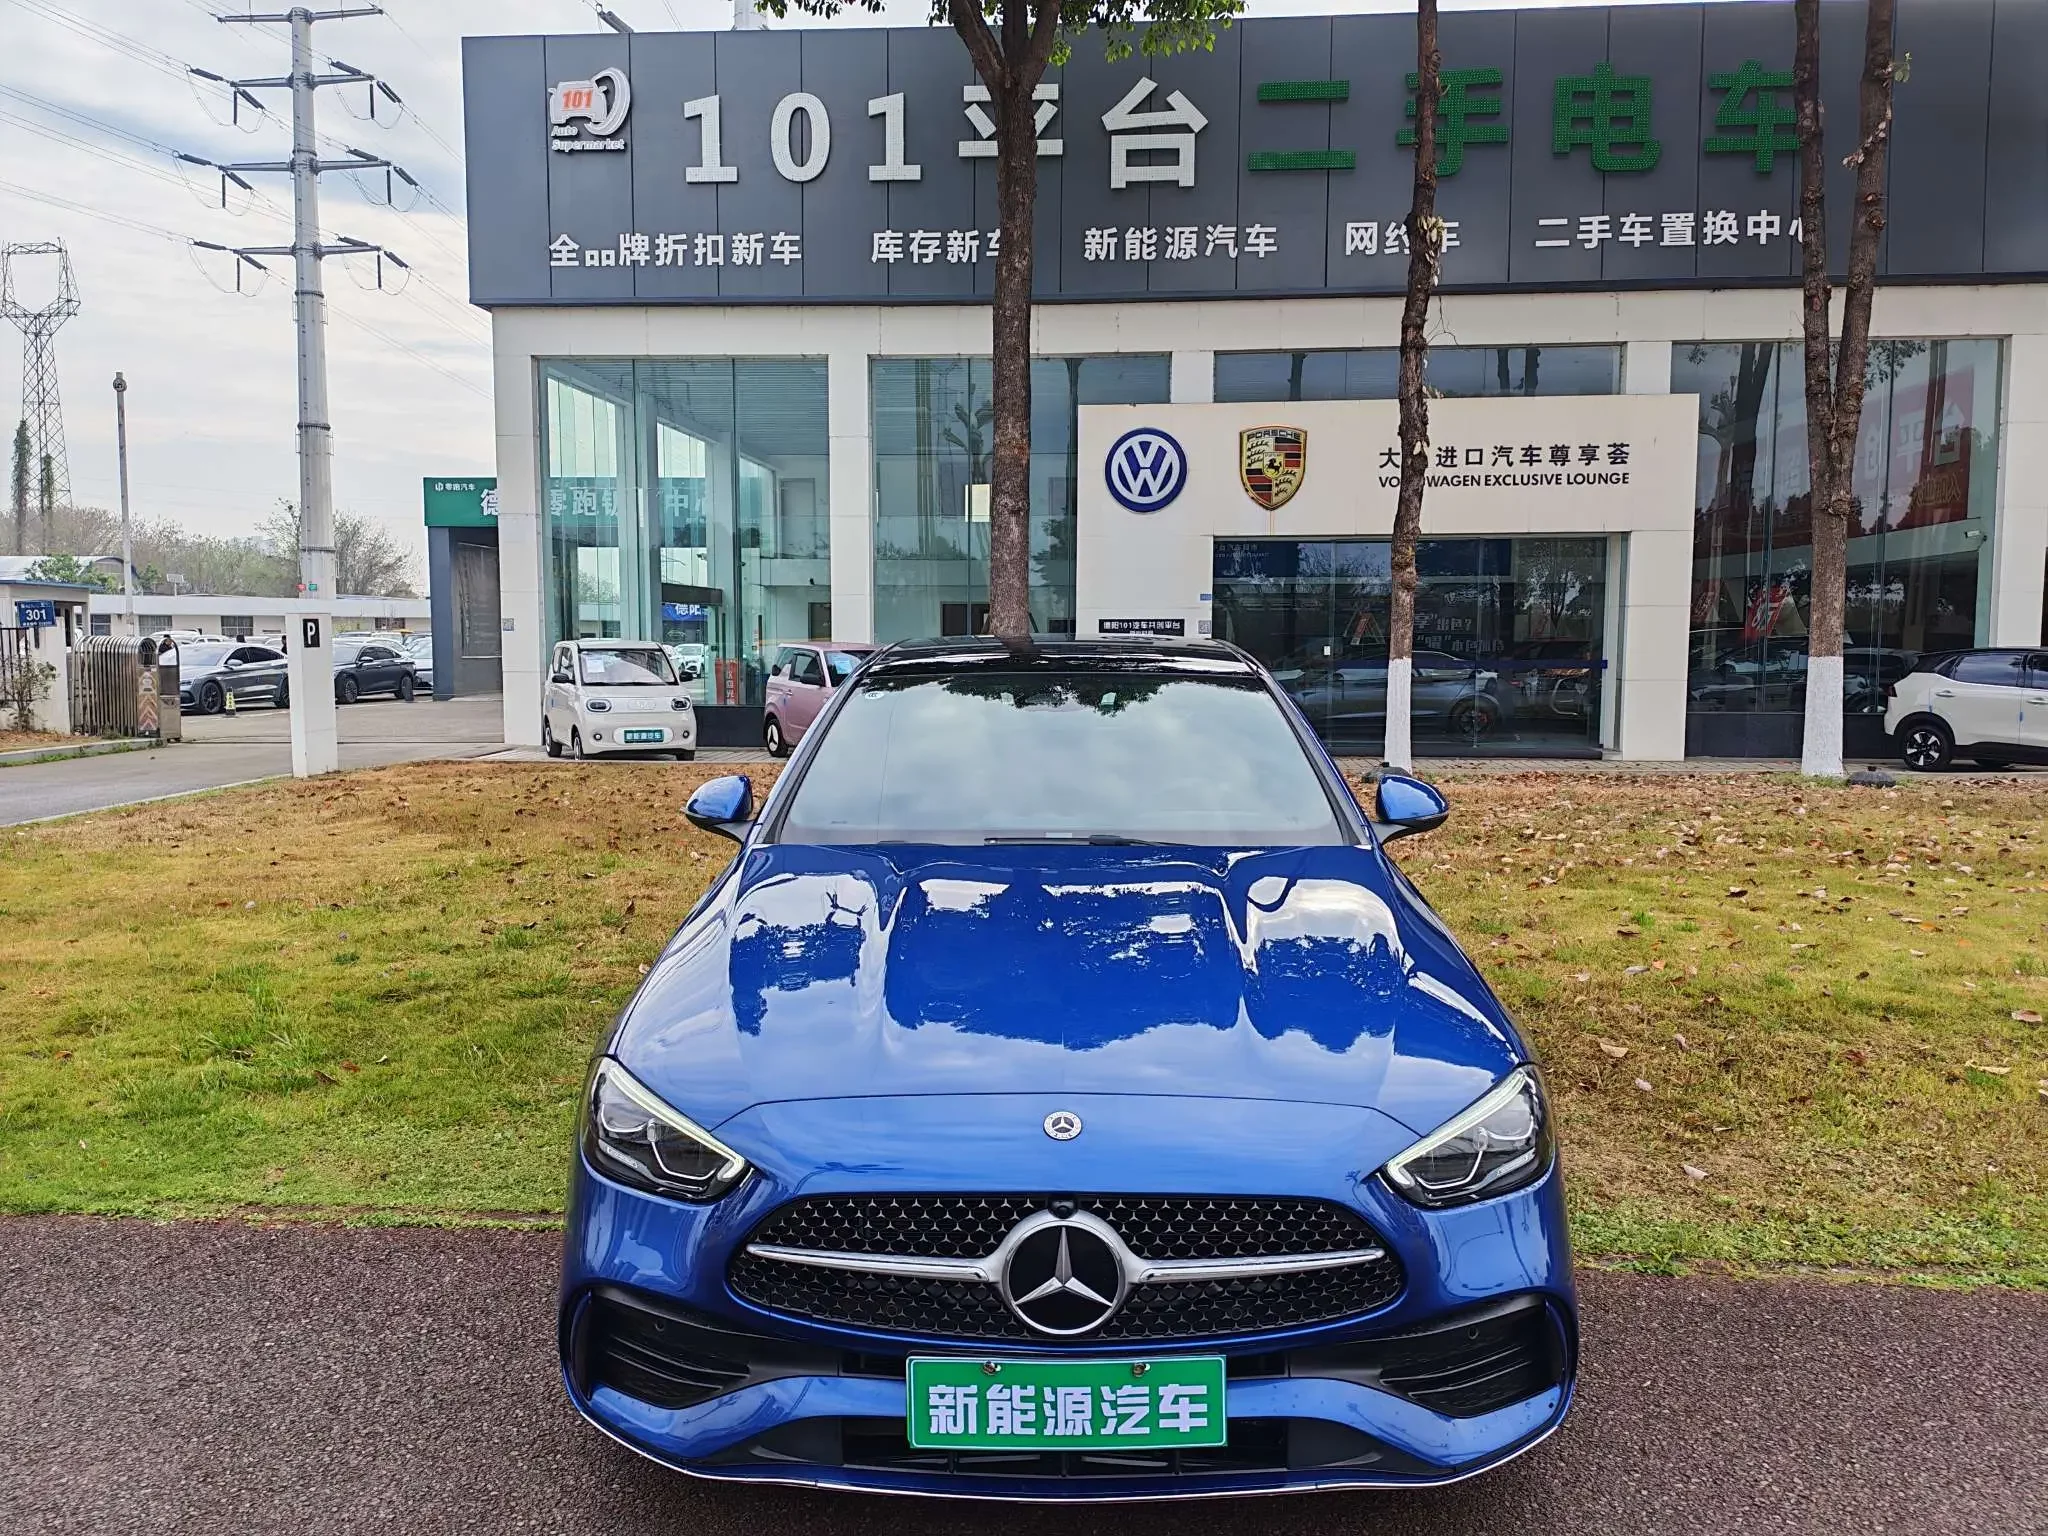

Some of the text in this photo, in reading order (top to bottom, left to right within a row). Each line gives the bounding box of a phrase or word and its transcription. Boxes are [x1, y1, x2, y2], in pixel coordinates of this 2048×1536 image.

[562, 90, 592, 109] 101
[551, 125, 578, 136] Auto
[551, 139, 625, 152] Supermarket
[549, 232, 802, 267] 全品牌折扣新车
[1083, 223, 1278, 261] 新能源汽车
[1247, 429, 1302, 441] PORSCHE
[1379, 443, 1630, 468] 大进口汽车尊享荟
[1379, 472, 1630, 488] VOWAGEN EXCLUSIVE LOUNGE
[25, 609, 47, 621] 301
[307, 621, 316, 645] P
[928, 1384, 1208, 1436] 新能源汽车
